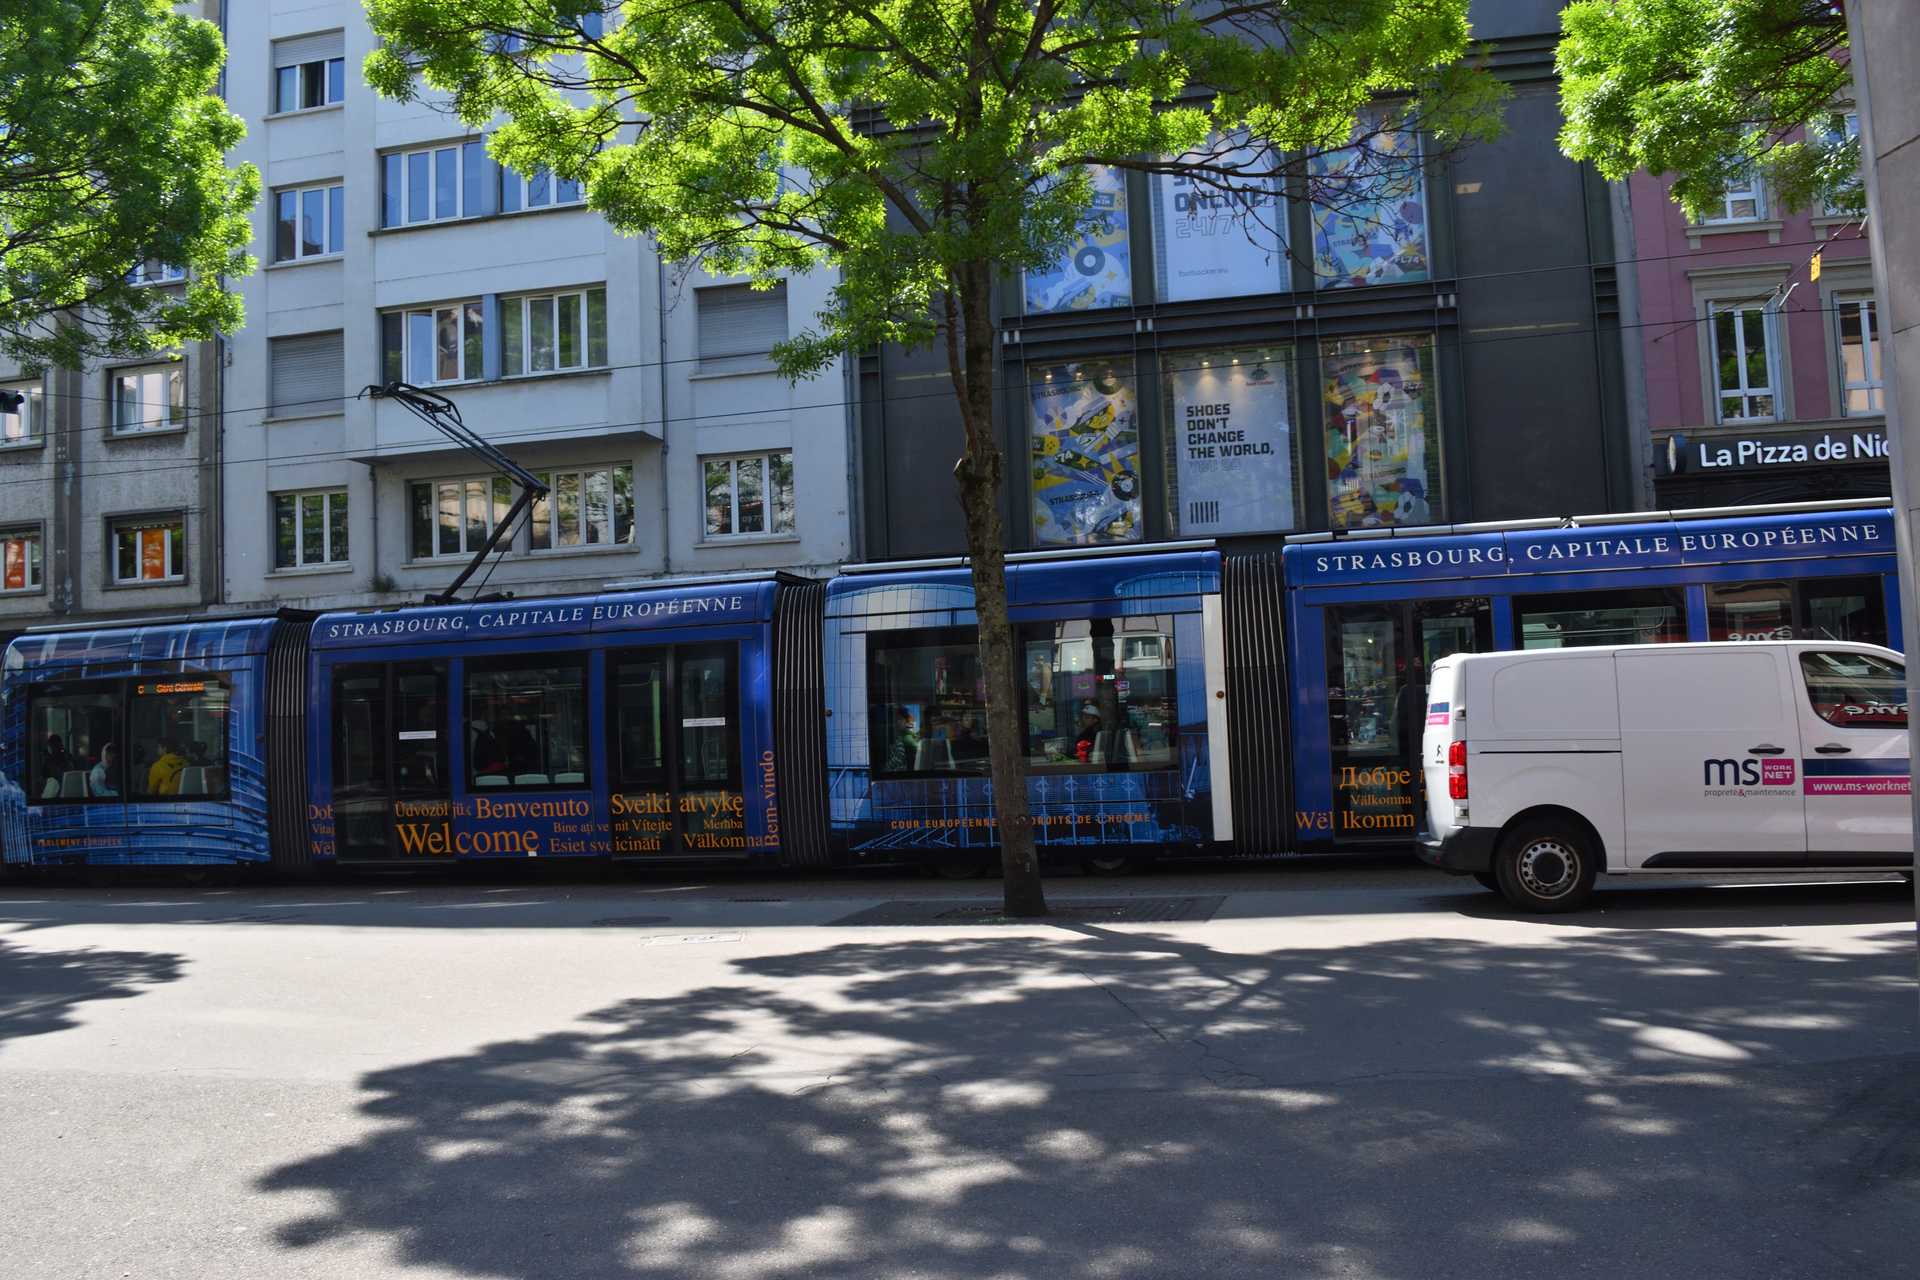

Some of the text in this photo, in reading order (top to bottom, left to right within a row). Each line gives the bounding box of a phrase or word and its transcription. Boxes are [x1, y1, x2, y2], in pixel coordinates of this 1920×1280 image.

[1186, 403, 1231, 418] SHOES
[1187, 417, 1230, 432] DON'T
[1188, 430, 1246, 446] CHANGE
[1188, 442, 1275, 460] THE WORLD,
[1700, 443, 1733, 468] La
[1738, 440, 1808, 465] Pizza
[1814, 435, 1848, 461] de
[1316, 524, 1880, 573] STRASBOURG, CAPITALE EUROPÉENNE
[329, 595, 743, 638] STRASBOURG, CAPITALE EUROPÉENNE
[1340, 766, 1412, 791] Добре
[1704, 758, 1760, 786] ms
[1763, 764, 1793, 772] WORK
[1763, 771, 1793, 780] NET
[476, 797, 590, 820] Benvenuto
[612, 792, 673, 814] Sveiki
[760, 750, 781, 847] Bem-vindo
[395, 822, 541, 855] Welcome
[549, 837, 586, 853] Esiet
